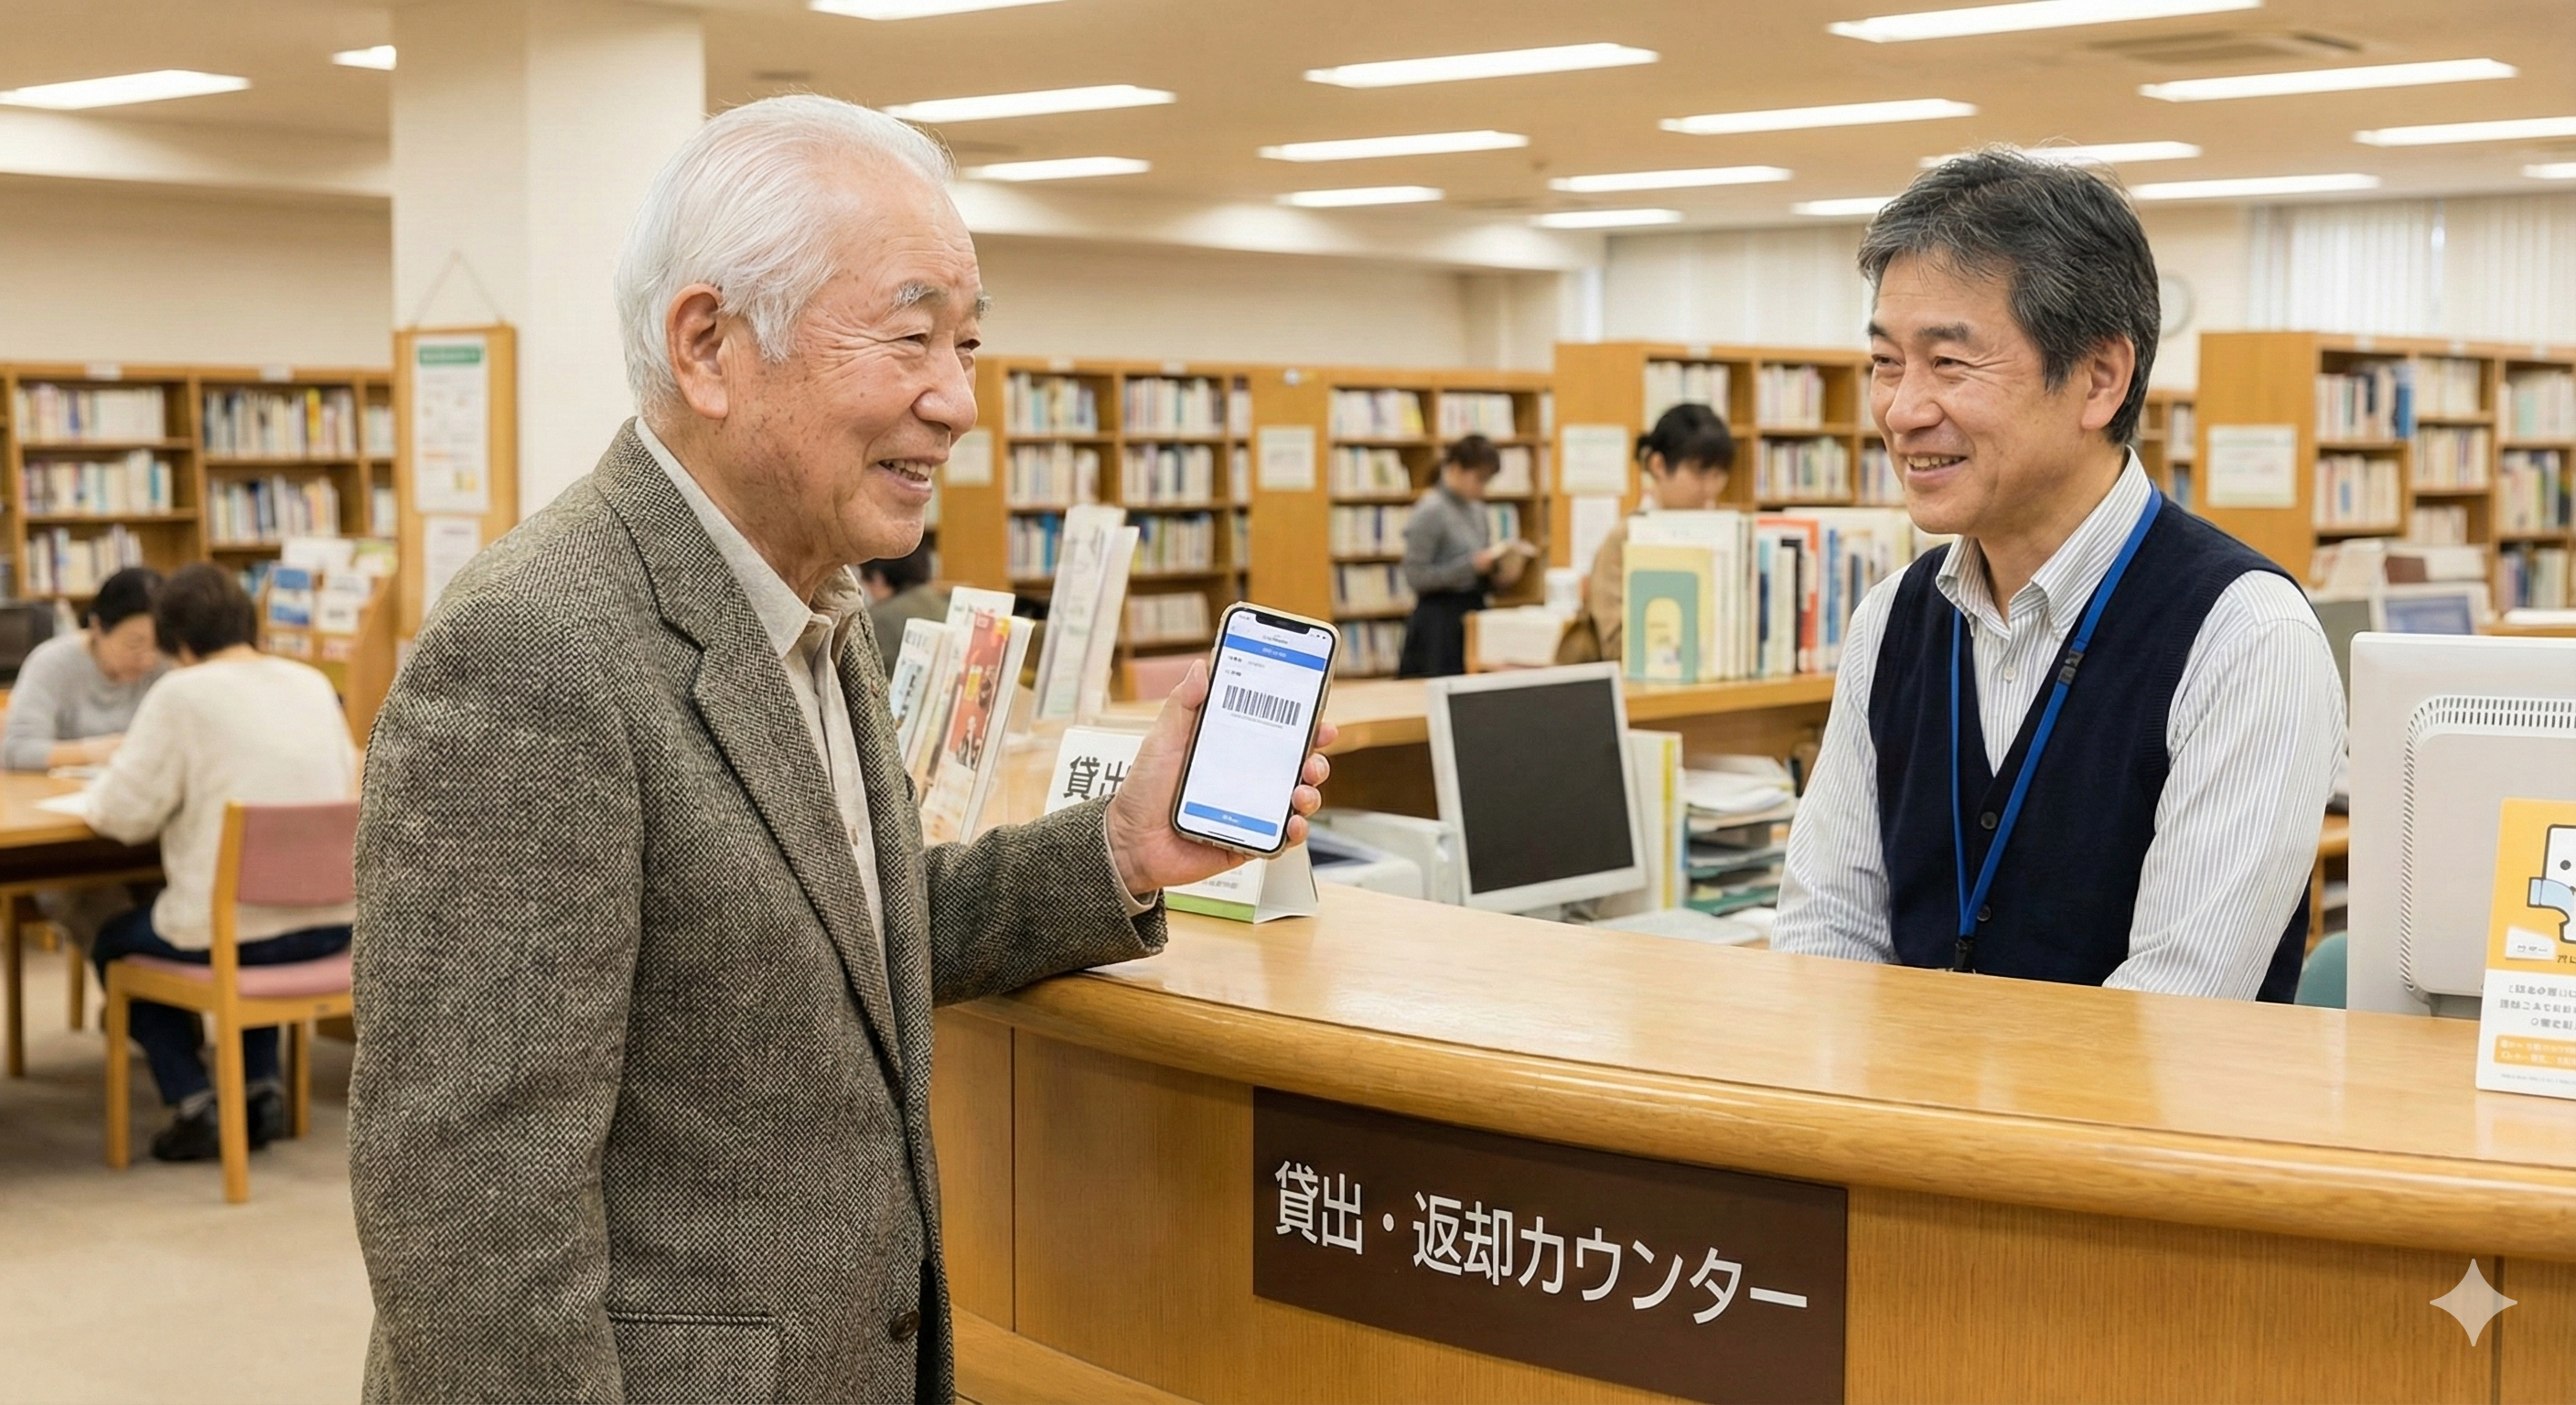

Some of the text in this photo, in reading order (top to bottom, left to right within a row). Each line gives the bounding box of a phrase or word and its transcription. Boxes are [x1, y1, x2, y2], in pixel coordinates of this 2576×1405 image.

[1274, 1160, 1808, 1325] 貸出・返却カウンター
